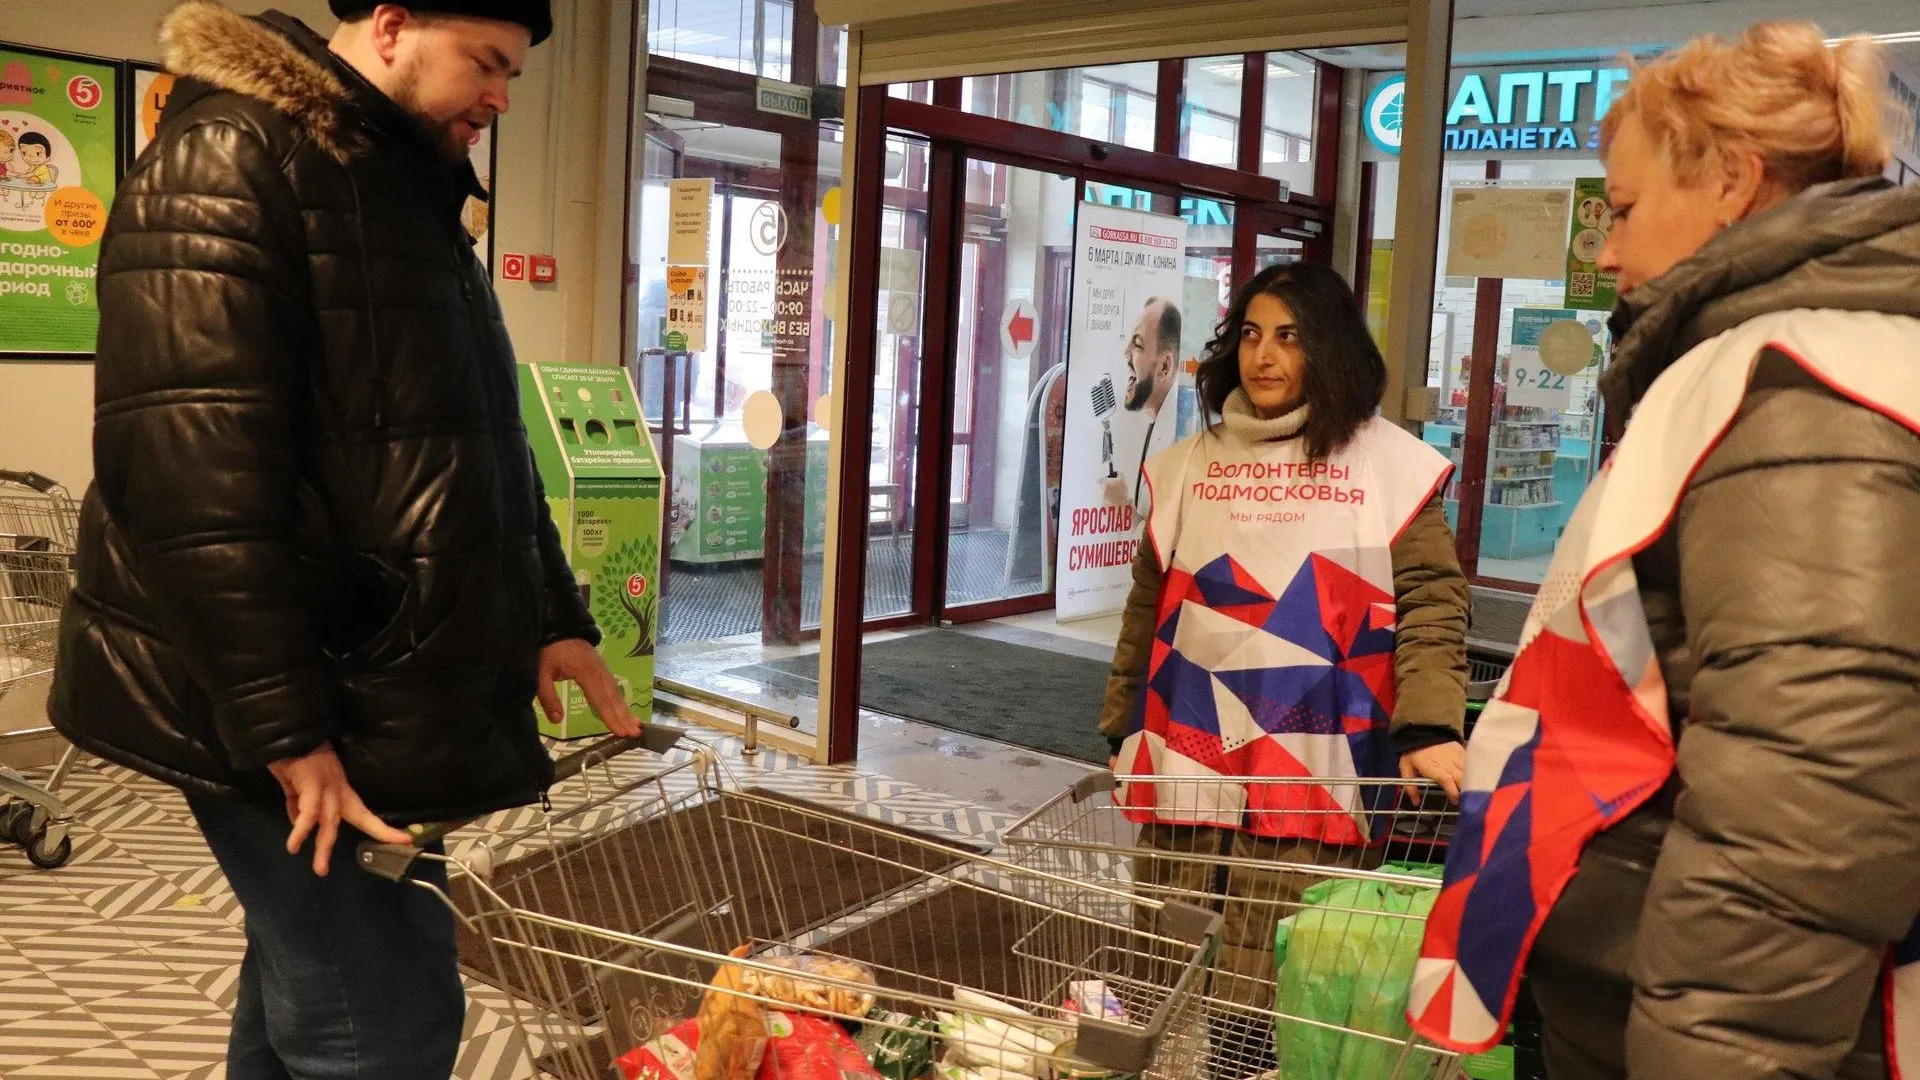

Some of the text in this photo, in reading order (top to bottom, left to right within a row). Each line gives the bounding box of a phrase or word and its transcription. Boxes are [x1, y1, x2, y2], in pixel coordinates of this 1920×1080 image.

[762, 92, 808, 114] ВЫХОД
[1444, 127, 1577, 150] ПЛАНЕТА
[64, 201, 98, 210] другие
[61, 210, 91, 219] призы
[1102, 229, 1138, 243] GORKASSA.RU
[1088, 246, 1094, 262] 6
[1095, 248, 1119, 266] МАРТА
[1124, 251, 1134, 267] ДК
[1153, 255, 1177, 271] КОНИНА
[583, 448, 634, 457] Утилизируйте
[571, 455, 651, 465] батарейки правильно
[1192, 482, 1365, 506] ПОДМОСКОВЬЯ
[577, 510, 594, 518] 1000
[1071, 504, 1133, 536] ЯРОСЛАВ
[1230, 512, 1306, 523] МЫ РЯДОМ
[1068, 539, 1142, 571] СУМИШЕВС
